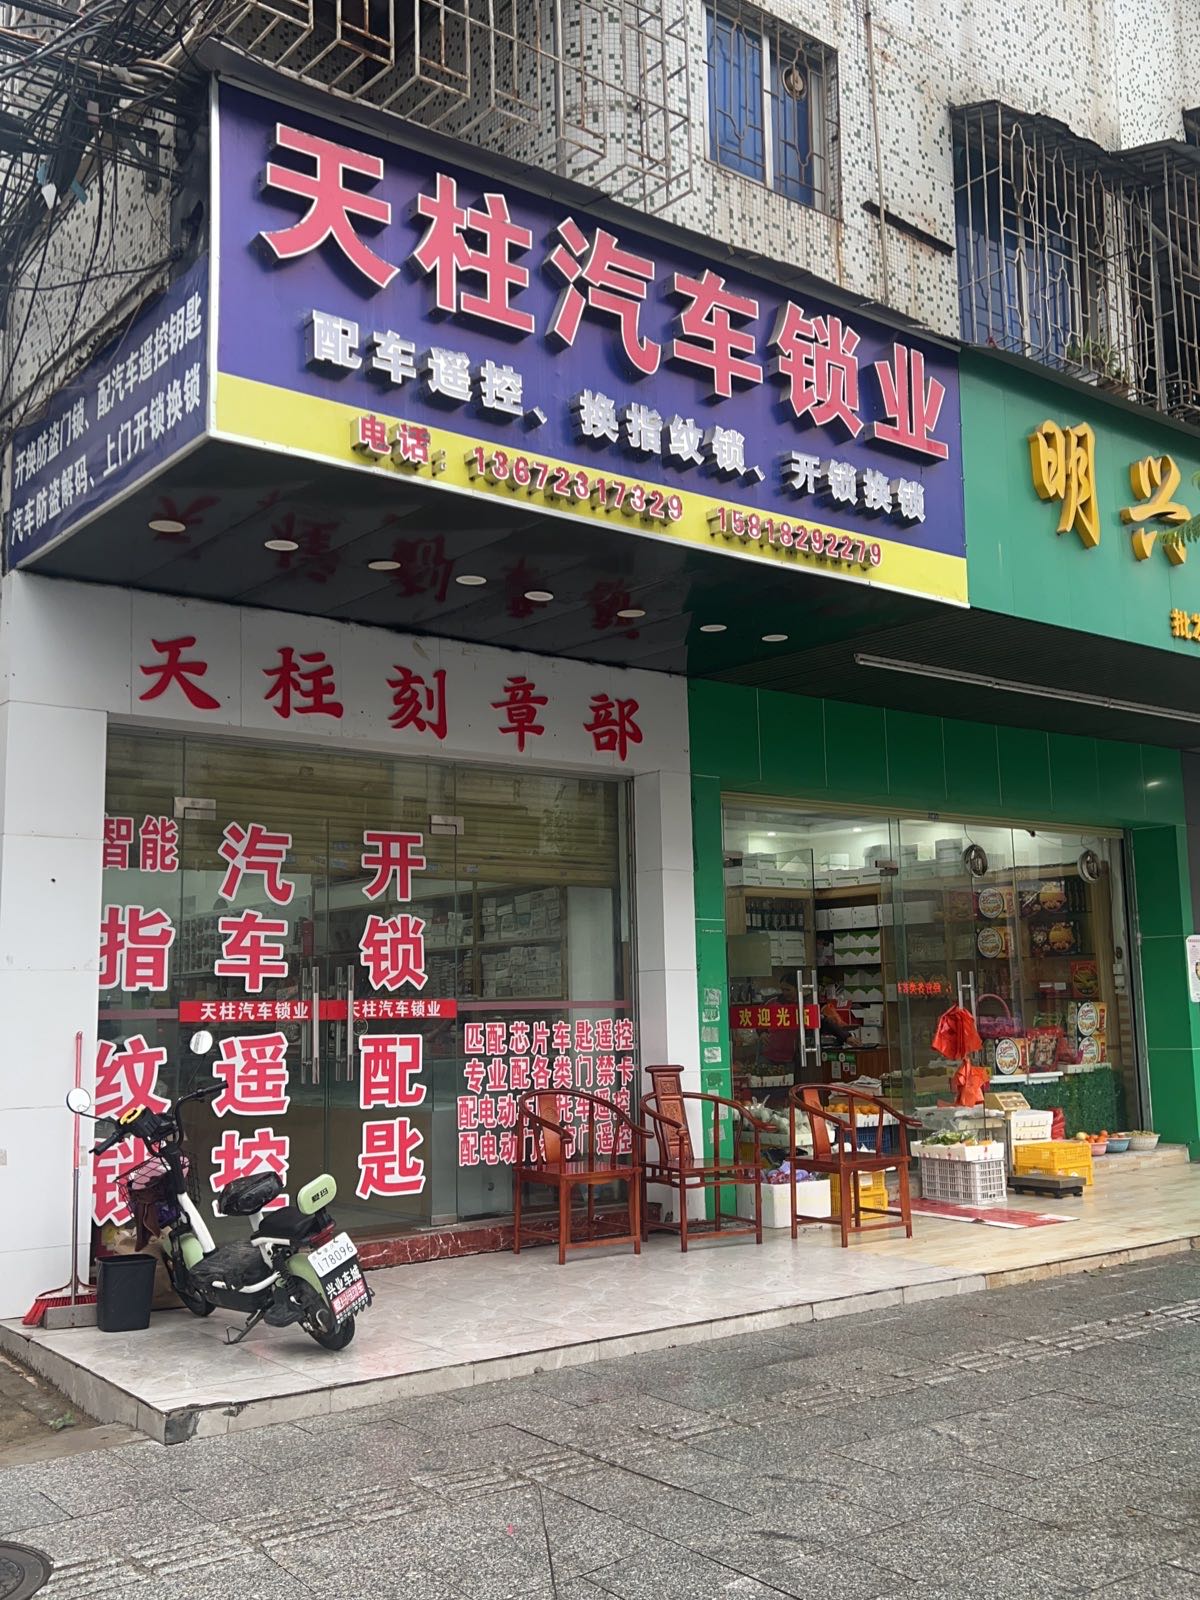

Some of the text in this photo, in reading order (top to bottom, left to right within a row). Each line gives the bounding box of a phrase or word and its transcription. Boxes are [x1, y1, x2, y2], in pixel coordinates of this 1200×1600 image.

[256, 121, 950, 461] 天柱汽车锁业
[471, 446, 683, 522] 13672317329
[716, 506, 882, 567] 15818292279
[139, 635, 646, 761] 天柱刻章部
[102, 814, 180, 874] 智能
[200, 1002, 309, 1021] 天柱汽车锁业
[355, 829, 428, 1201] 开锁配匙
[464, 1017, 634, 1056] 匹配芯片车匙遥控
[738, 1007, 810, 1027] 欢迎光临
[463, 1054, 635, 1094] 专业配各类门禁卡
[317, 1242, 354, 1272] 178096
